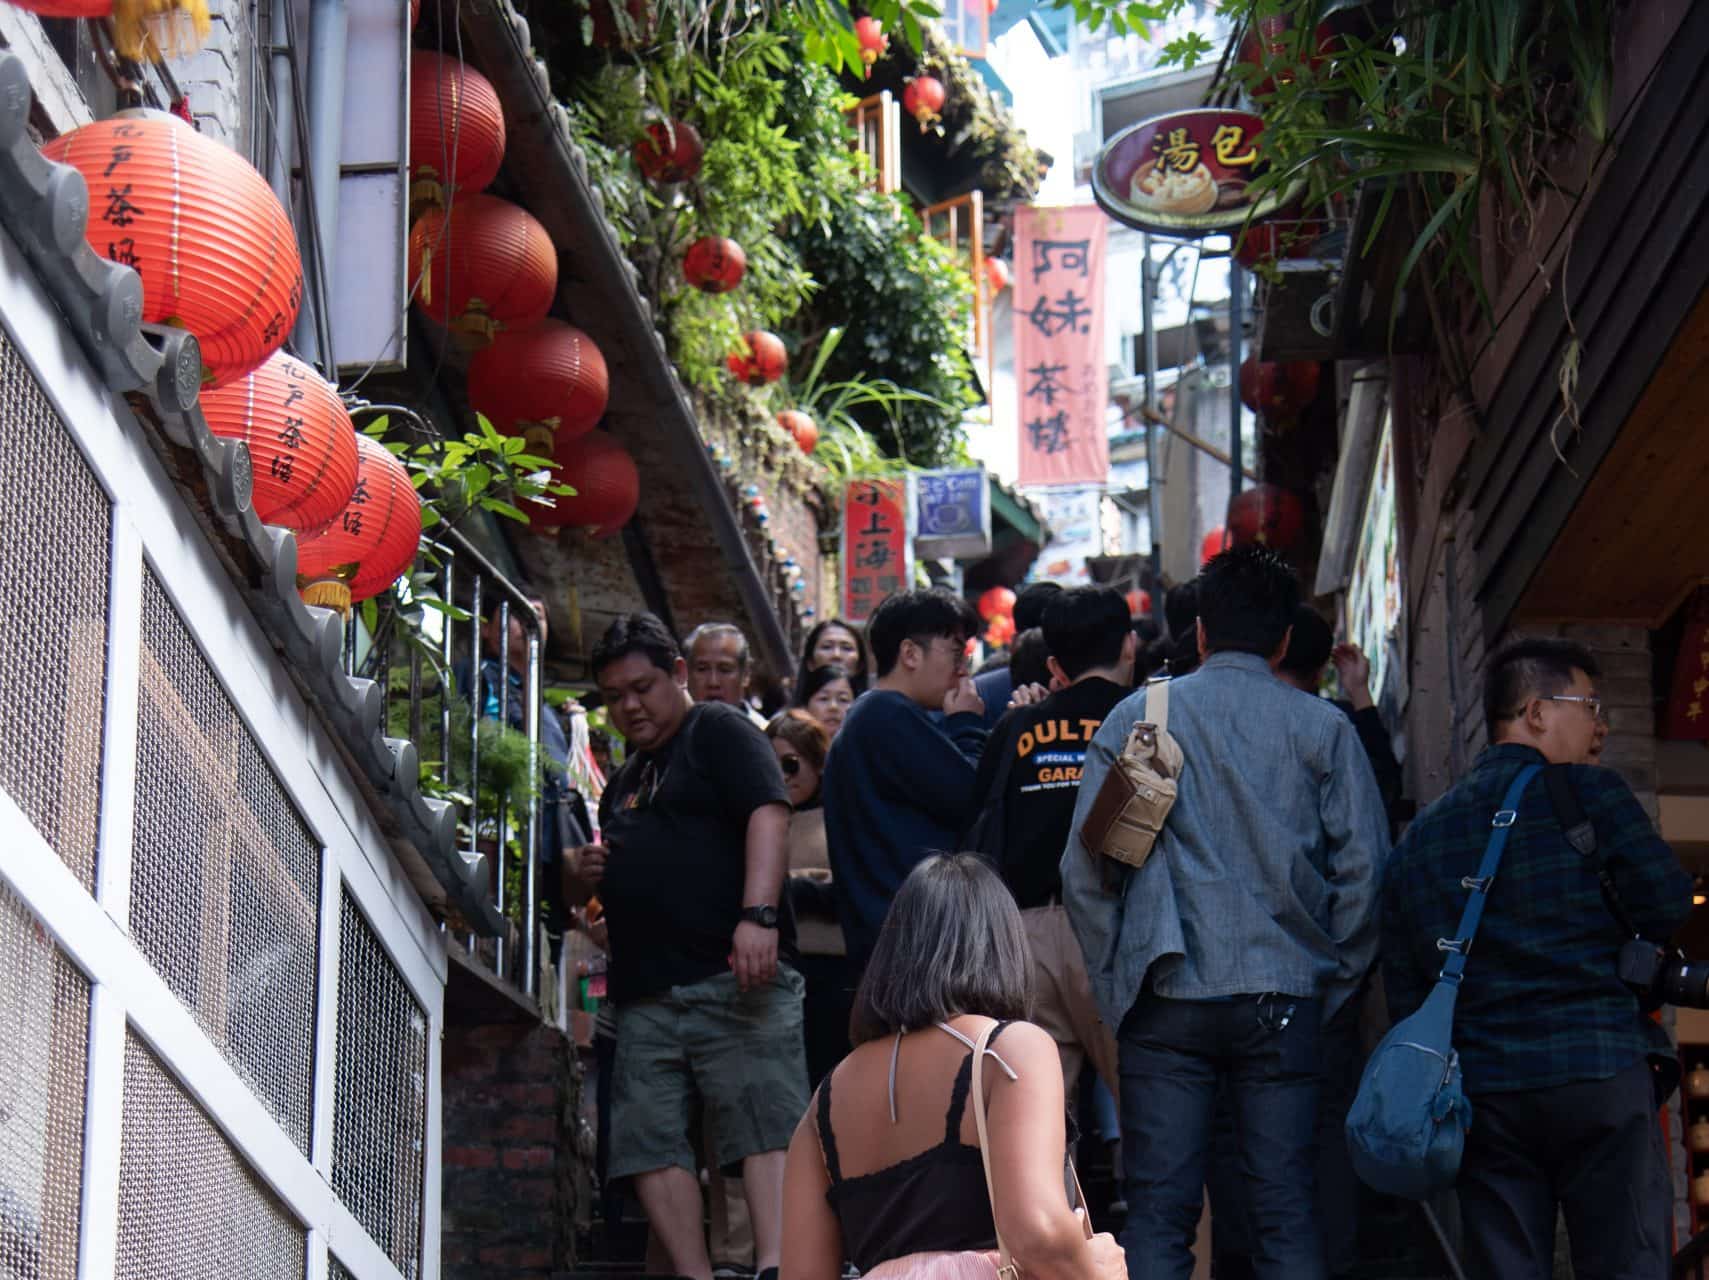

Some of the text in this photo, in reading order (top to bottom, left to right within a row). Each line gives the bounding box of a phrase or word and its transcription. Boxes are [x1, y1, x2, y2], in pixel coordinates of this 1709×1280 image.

[1152, 124, 1257, 173] 湯包
[1025, 238, 1092, 454] 阿妹茶樓
